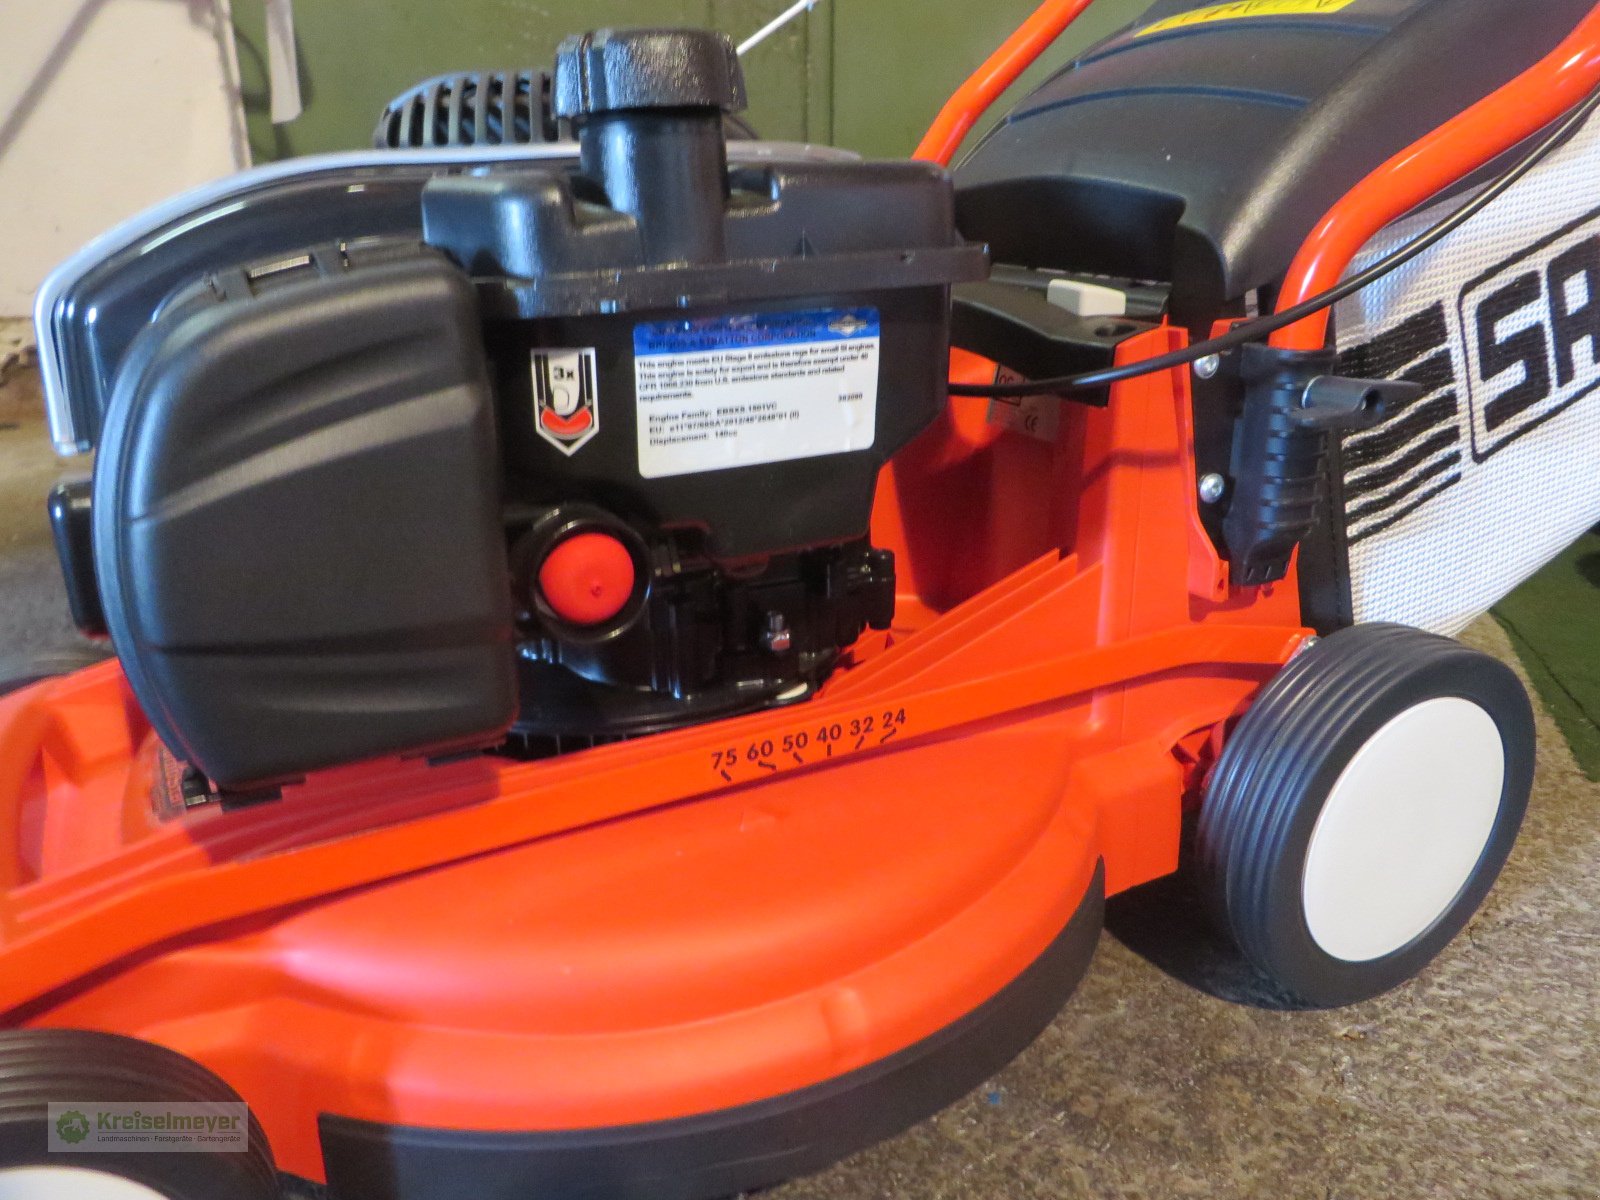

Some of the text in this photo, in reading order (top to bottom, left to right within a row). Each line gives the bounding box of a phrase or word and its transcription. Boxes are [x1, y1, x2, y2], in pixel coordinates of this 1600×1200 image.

[639, 360, 656, 369] This
[657, 359, 685, 369] engine
[686, 357, 710, 366] meets
[725, 353, 747, 363] Stage
[754, 349, 791, 359] emissions
[809, 346, 820, 355] for
[820, 345, 839, 354] small
[640, 372, 657, 381] This
[657, 370, 685, 381] engine
[719, 365, 730, 375] for
[731, 363, 755, 374] export
[756, 361, 771, 371] and
[780, 358, 812, 369] therefore
[813, 355, 839, 366] exempt
[839, 353, 859, 363] under
[694, 378, 714, 387] from
[731, 373, 769, 384] emissions
[807, 367, 821, 377] and
[649, 411, 680, 424] Engine
[711, 708, 906, 770] 75 60 50 40 32 24
